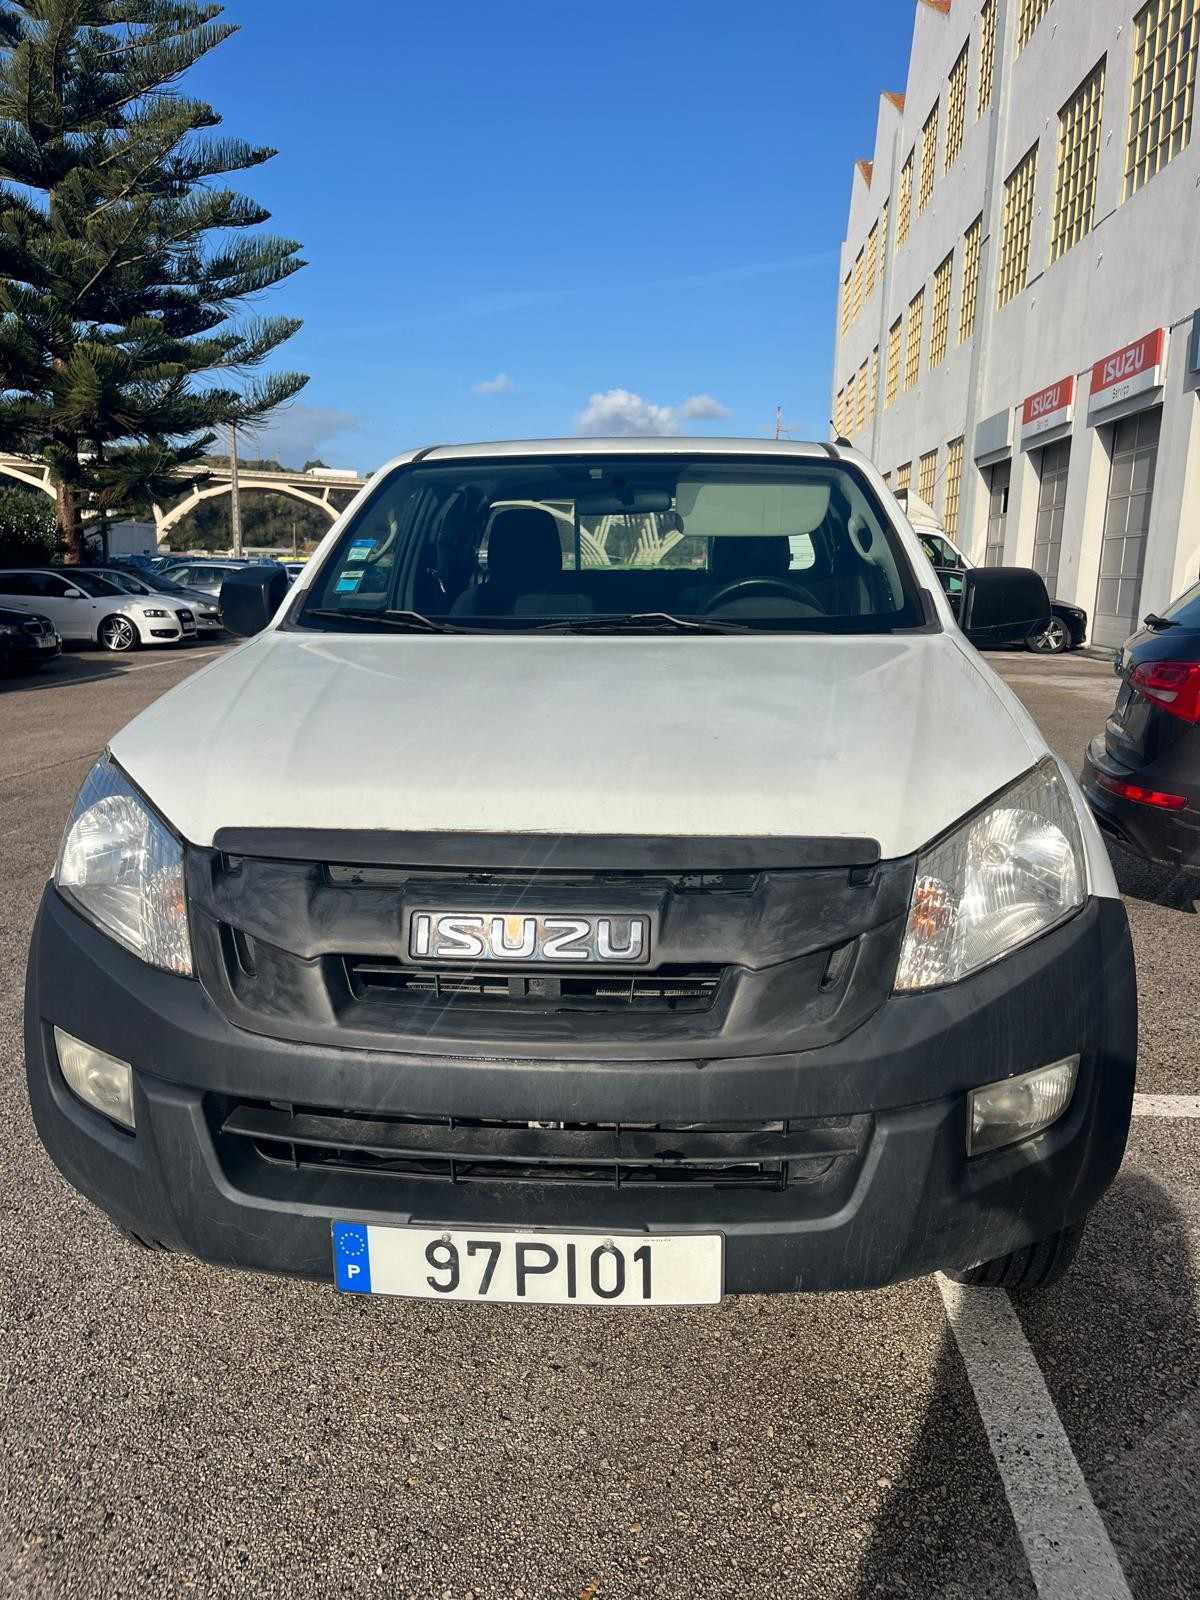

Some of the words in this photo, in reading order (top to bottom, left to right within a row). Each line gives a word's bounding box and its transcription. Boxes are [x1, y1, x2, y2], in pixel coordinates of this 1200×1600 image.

[1103, 344, 1145, 385] ISUZU
[1031, 386, 1060, 417] ISUZU
[416, 914, 643, 960] ISUZU
[347, 1264, 361, 1279] P
